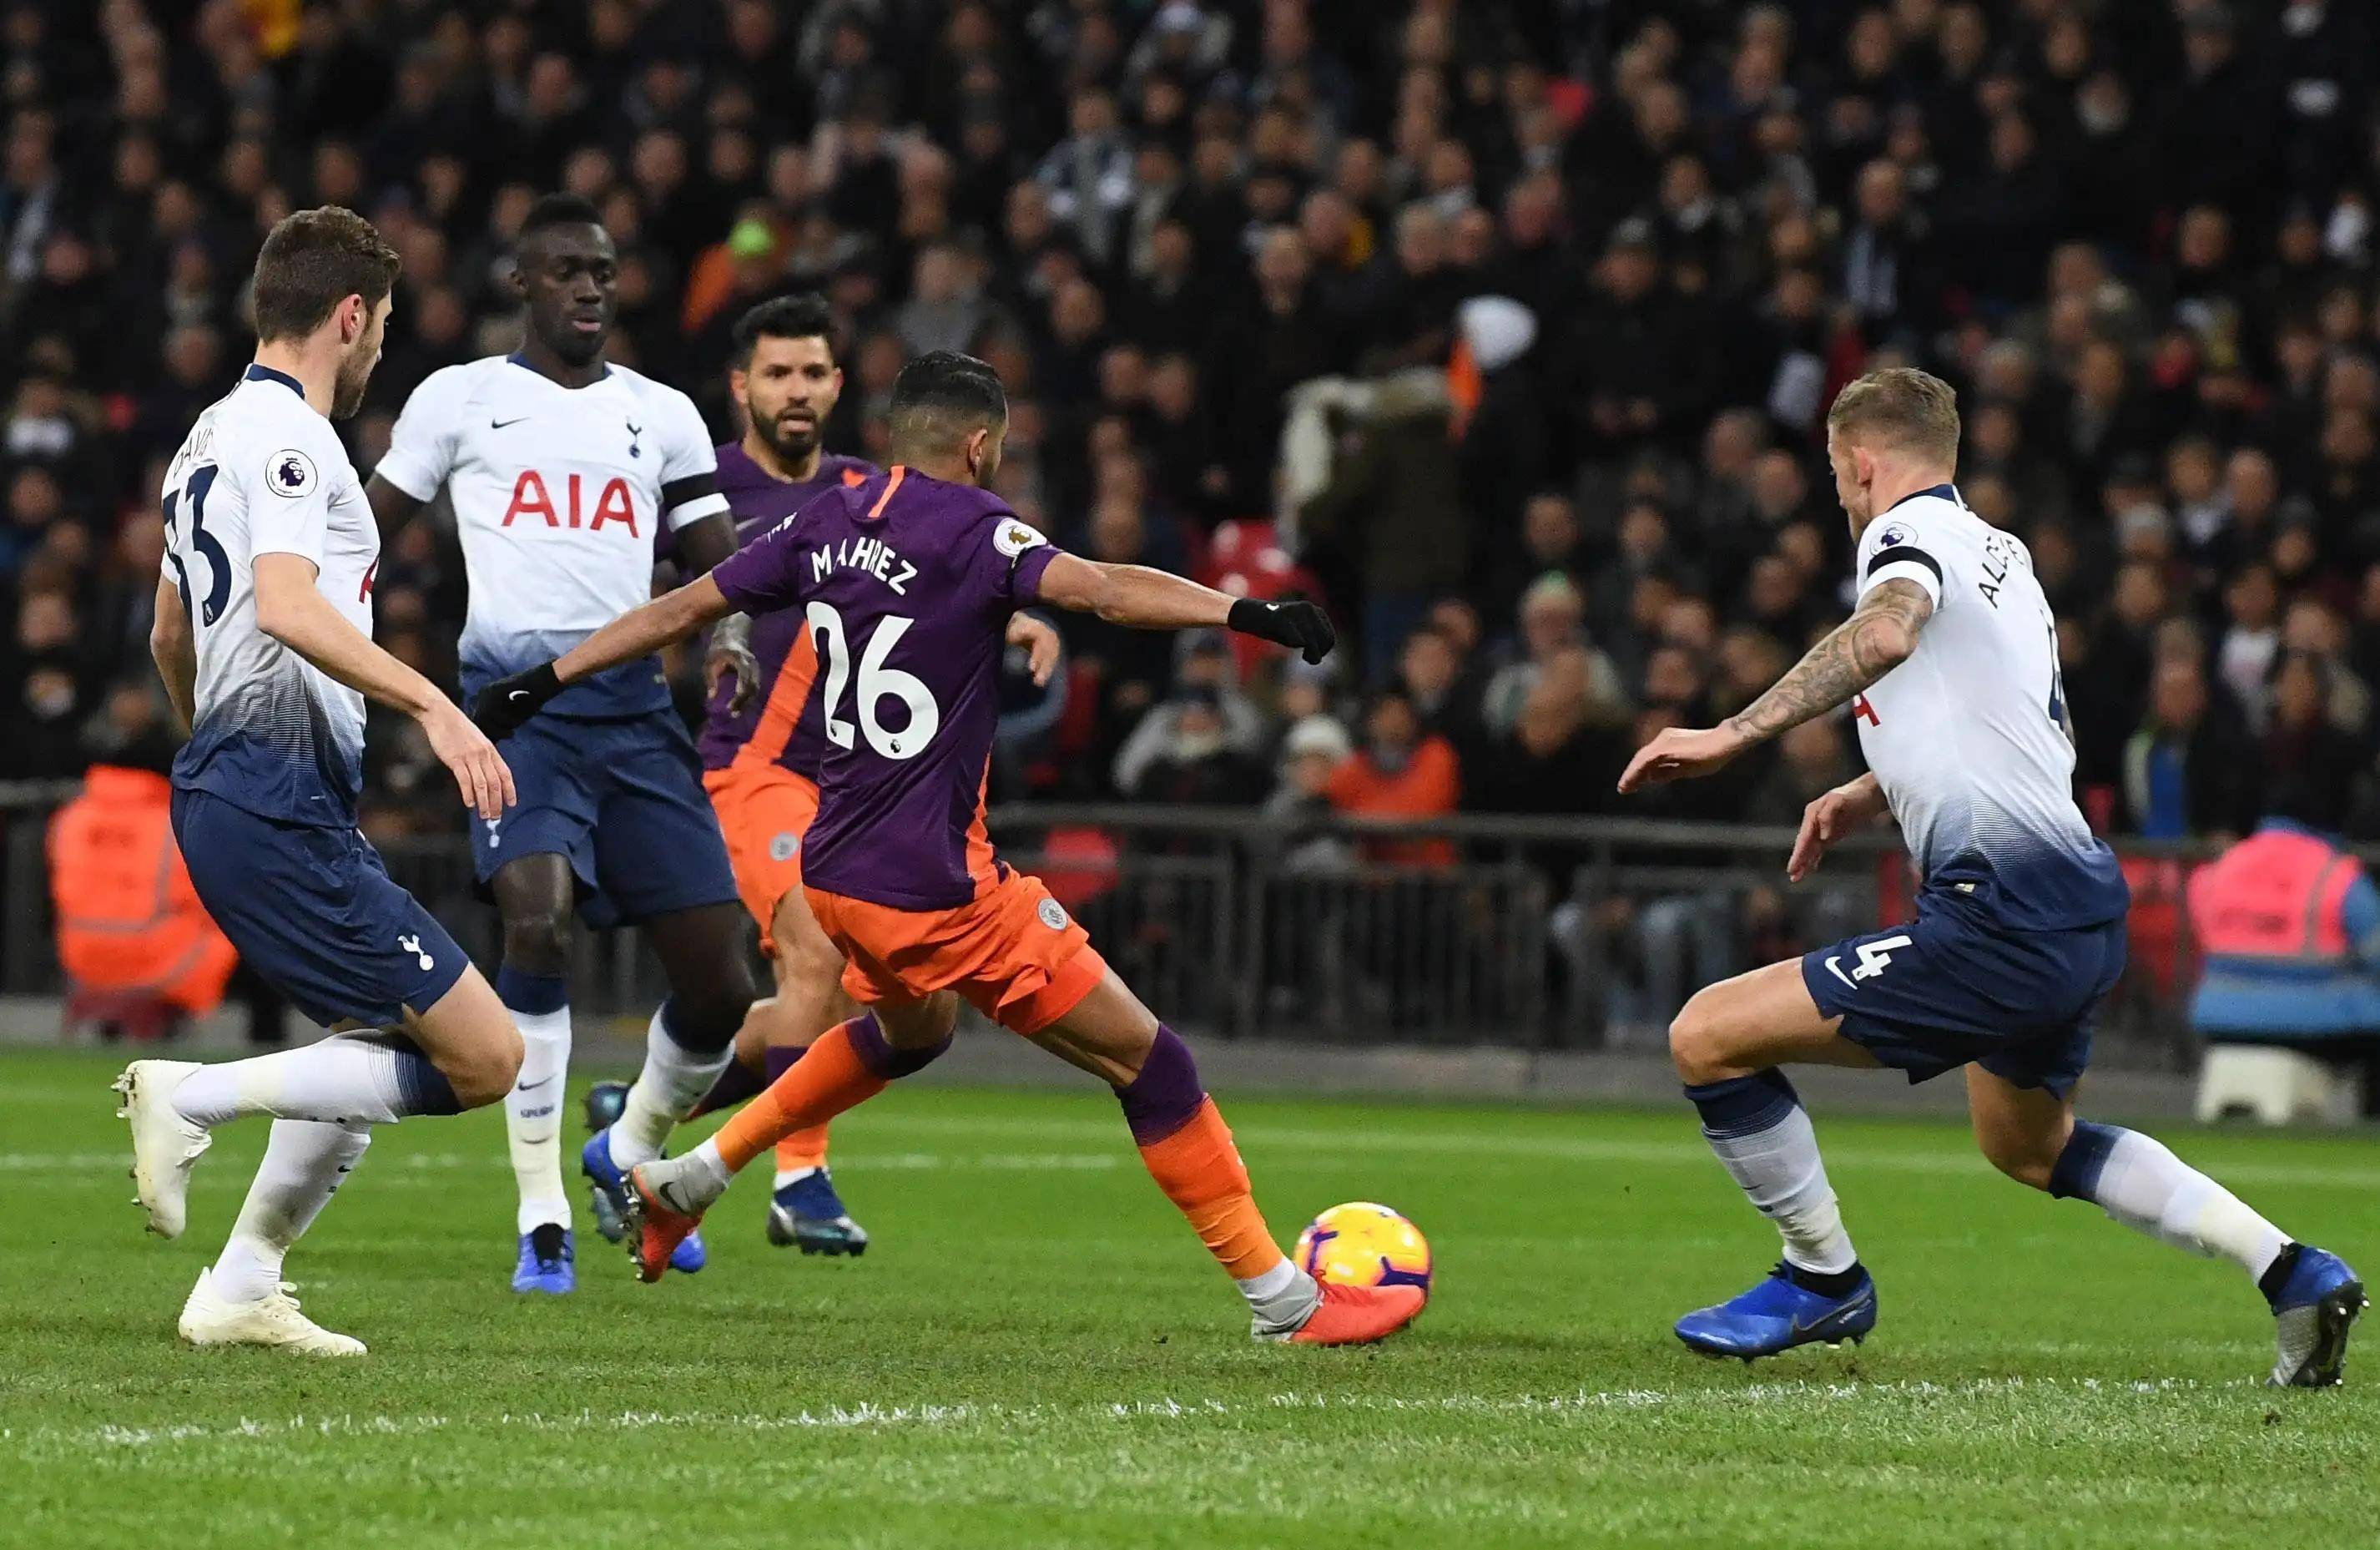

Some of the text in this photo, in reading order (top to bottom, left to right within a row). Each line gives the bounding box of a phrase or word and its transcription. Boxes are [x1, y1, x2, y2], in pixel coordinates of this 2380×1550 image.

[501, 470, 639, 538] AIA
[811, 537, 918, 596] MAHREZ
[806, 601, 939, 760] 26
[1851, 935, 1913, 982] 4
